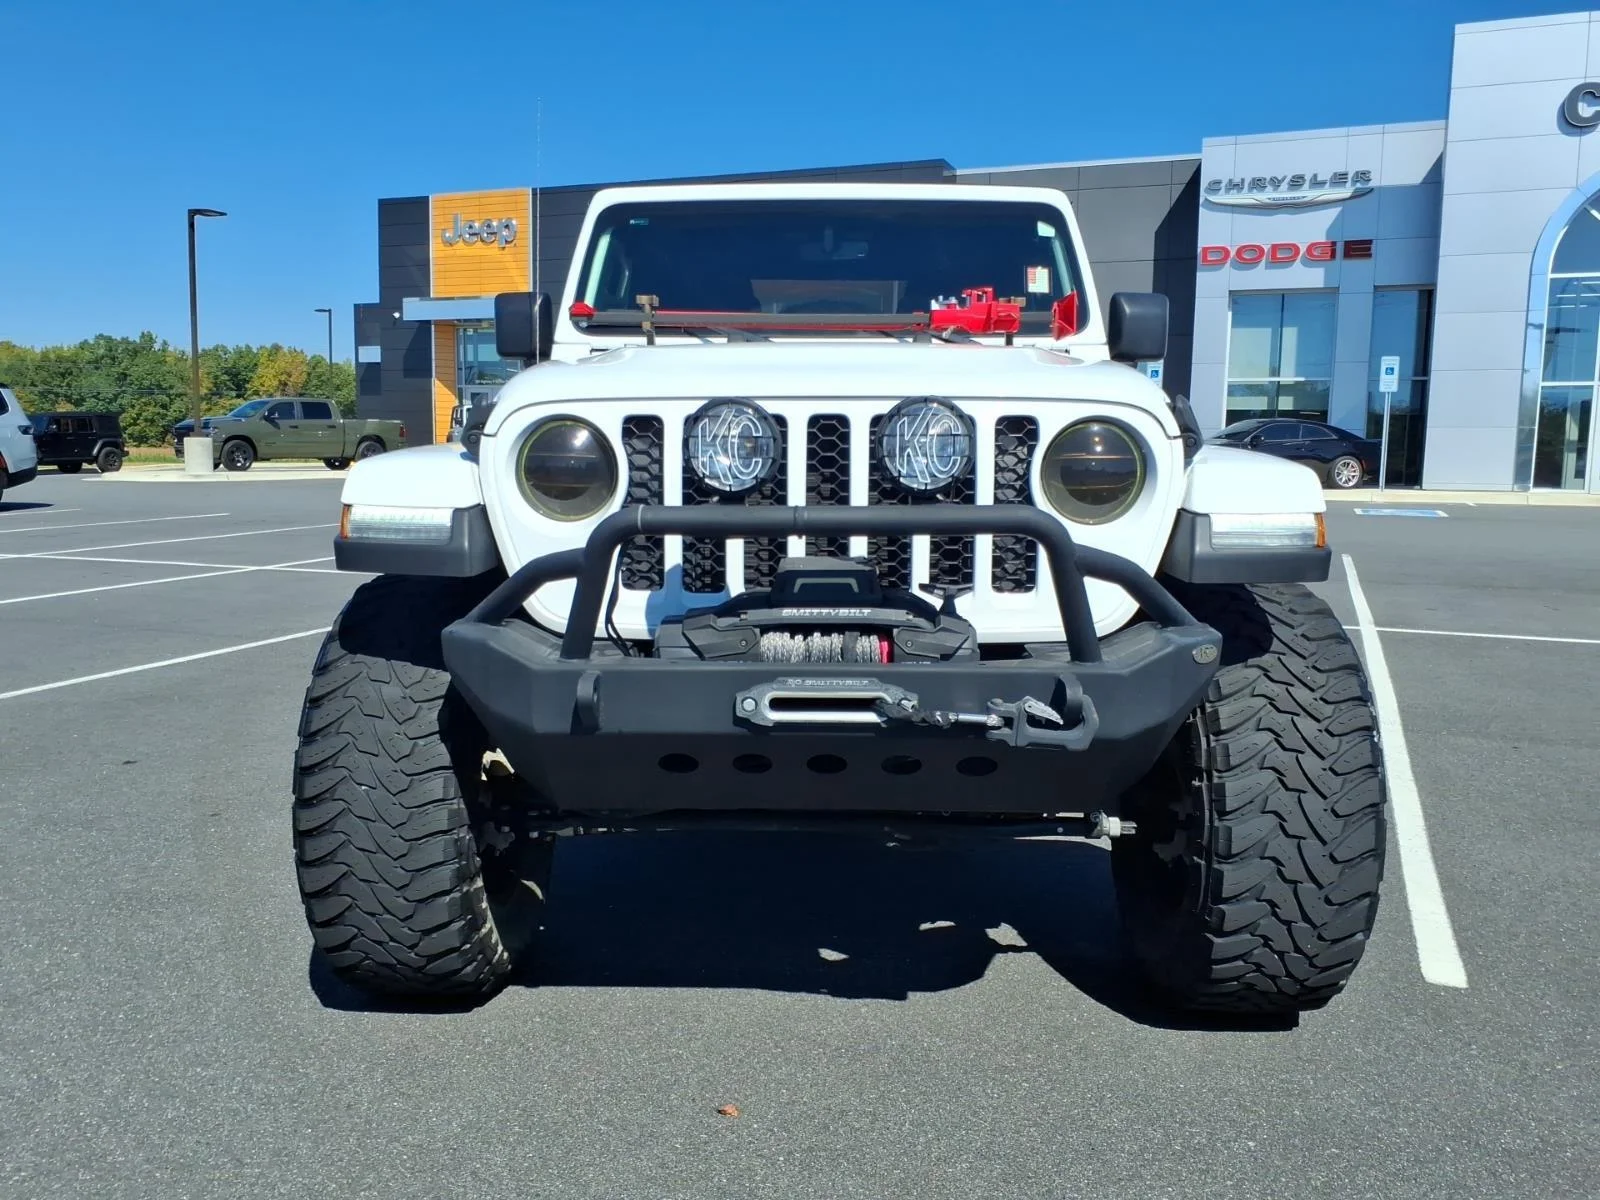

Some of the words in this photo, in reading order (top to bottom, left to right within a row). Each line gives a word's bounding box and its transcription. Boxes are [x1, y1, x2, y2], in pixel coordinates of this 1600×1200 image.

[1206, 169, 1373, 191] CHRYSLER
[441, 212, 517, 247] Jeep
[1200, 239, 1373, 266] DODGE
[700, 407, 762, 485] KC
[896, 407, 961, 484] KC
[781, 608, 872, 617] SMITTYBILT
